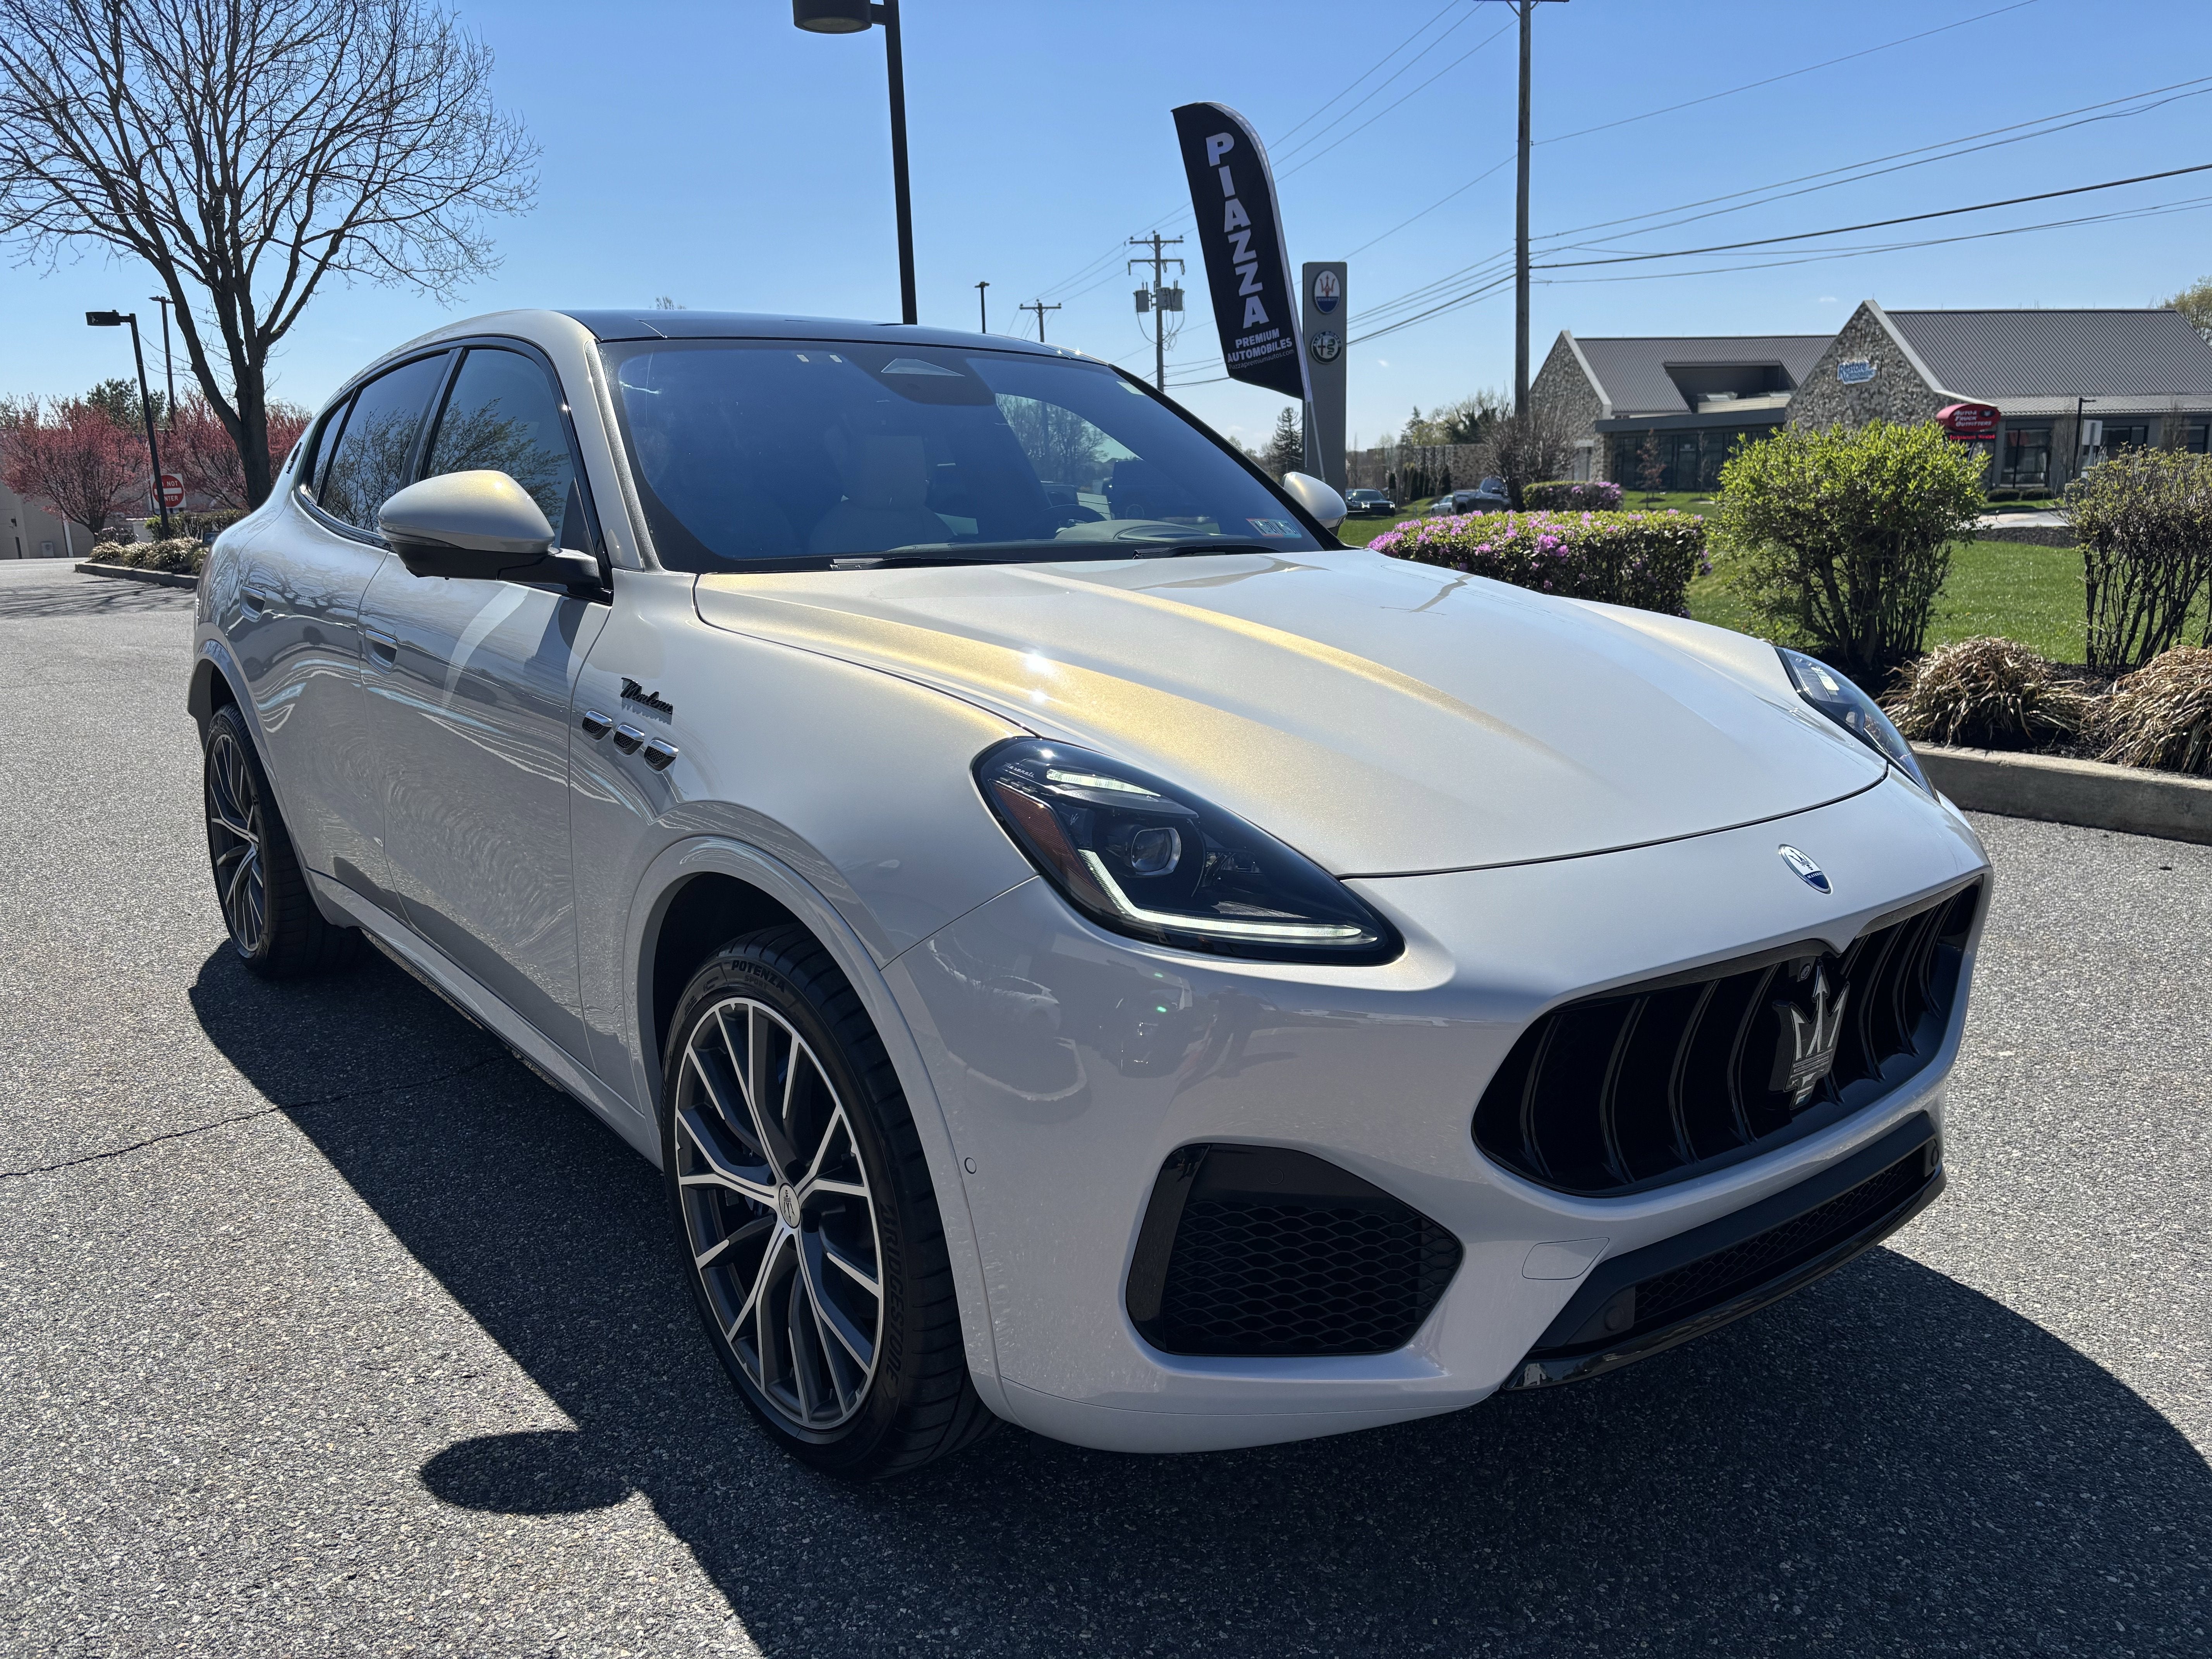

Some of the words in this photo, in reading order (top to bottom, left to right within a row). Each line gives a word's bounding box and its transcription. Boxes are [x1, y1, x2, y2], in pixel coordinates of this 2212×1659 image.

[1206, 132, 1269, 328] PIAZZA
[1228, 337, 1292, 363] AUTOMOBILES
[1235, 328, 1279, 348] PREMIUM
[1003, 762, 1035, 778] Maserati
[731, 960, 785, 993] POTENZA
[745, 975, 769, 989] SPORT
[878, 1200, 905, 1386] BRIDGESTONE
